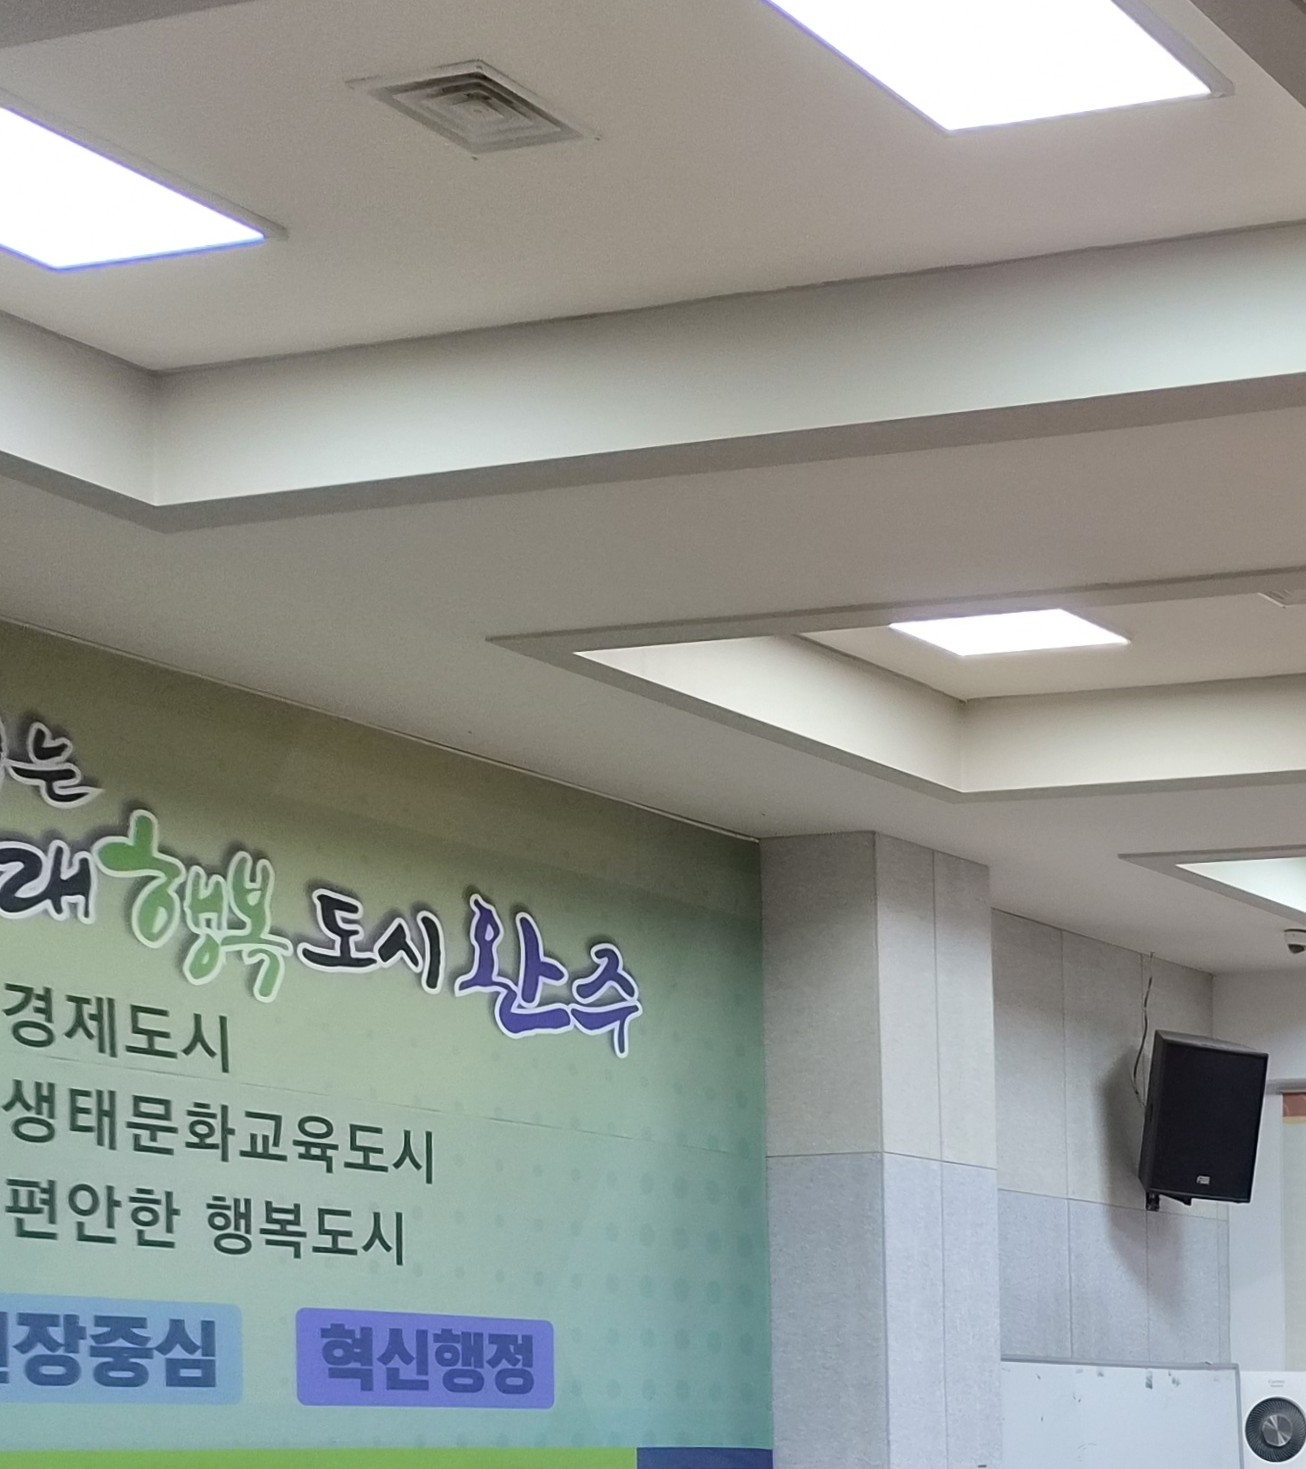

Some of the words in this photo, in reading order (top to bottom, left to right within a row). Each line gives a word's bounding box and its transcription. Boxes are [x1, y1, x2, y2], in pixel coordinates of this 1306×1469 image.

[0, 718, 104, 808] 는
[454, 893, 643, 1058] 완주
[2, 982, 230, 1073] 경제도시
[2, 1078, 433, 1185] 생태문화교육도시
[4, 1177, 181, 1249] 편안한
[206, 1195, 404, 1266] 행복도시
[0, 1310, 218, 1388] 장중심
[320, 1323, 535, 1395] 혁신행정
